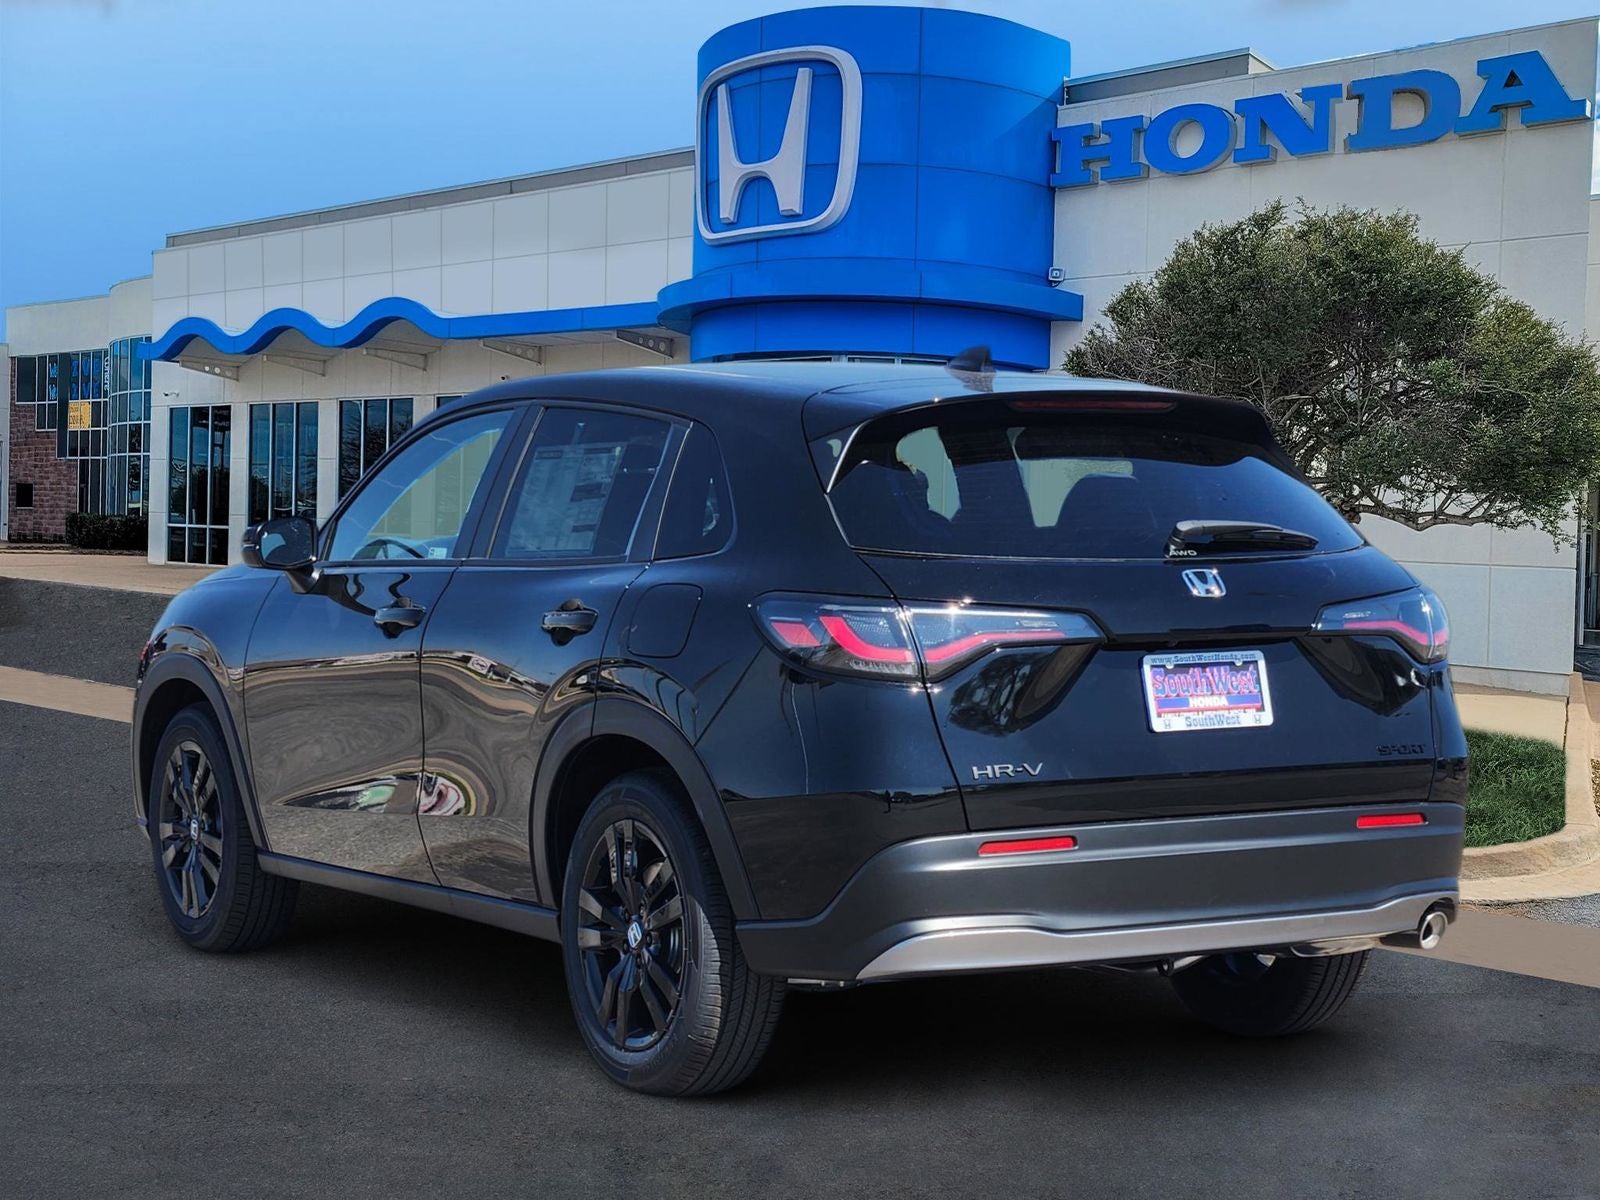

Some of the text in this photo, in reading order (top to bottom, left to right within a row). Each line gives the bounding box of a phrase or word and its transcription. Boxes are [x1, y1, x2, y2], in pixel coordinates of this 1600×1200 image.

[1051, 50, 1590, 187] HONDA
[1169, 549, 1198, 557] AWD
[1151, 664, 1260, 697] SouthWest
[1188, 695, 1230, 709] HONDA
[1184, 713, 1241, 728] SouthWest
[1376, 744, 1426, 756] SPORT
[971, 762, 1044, 780] HR-V
